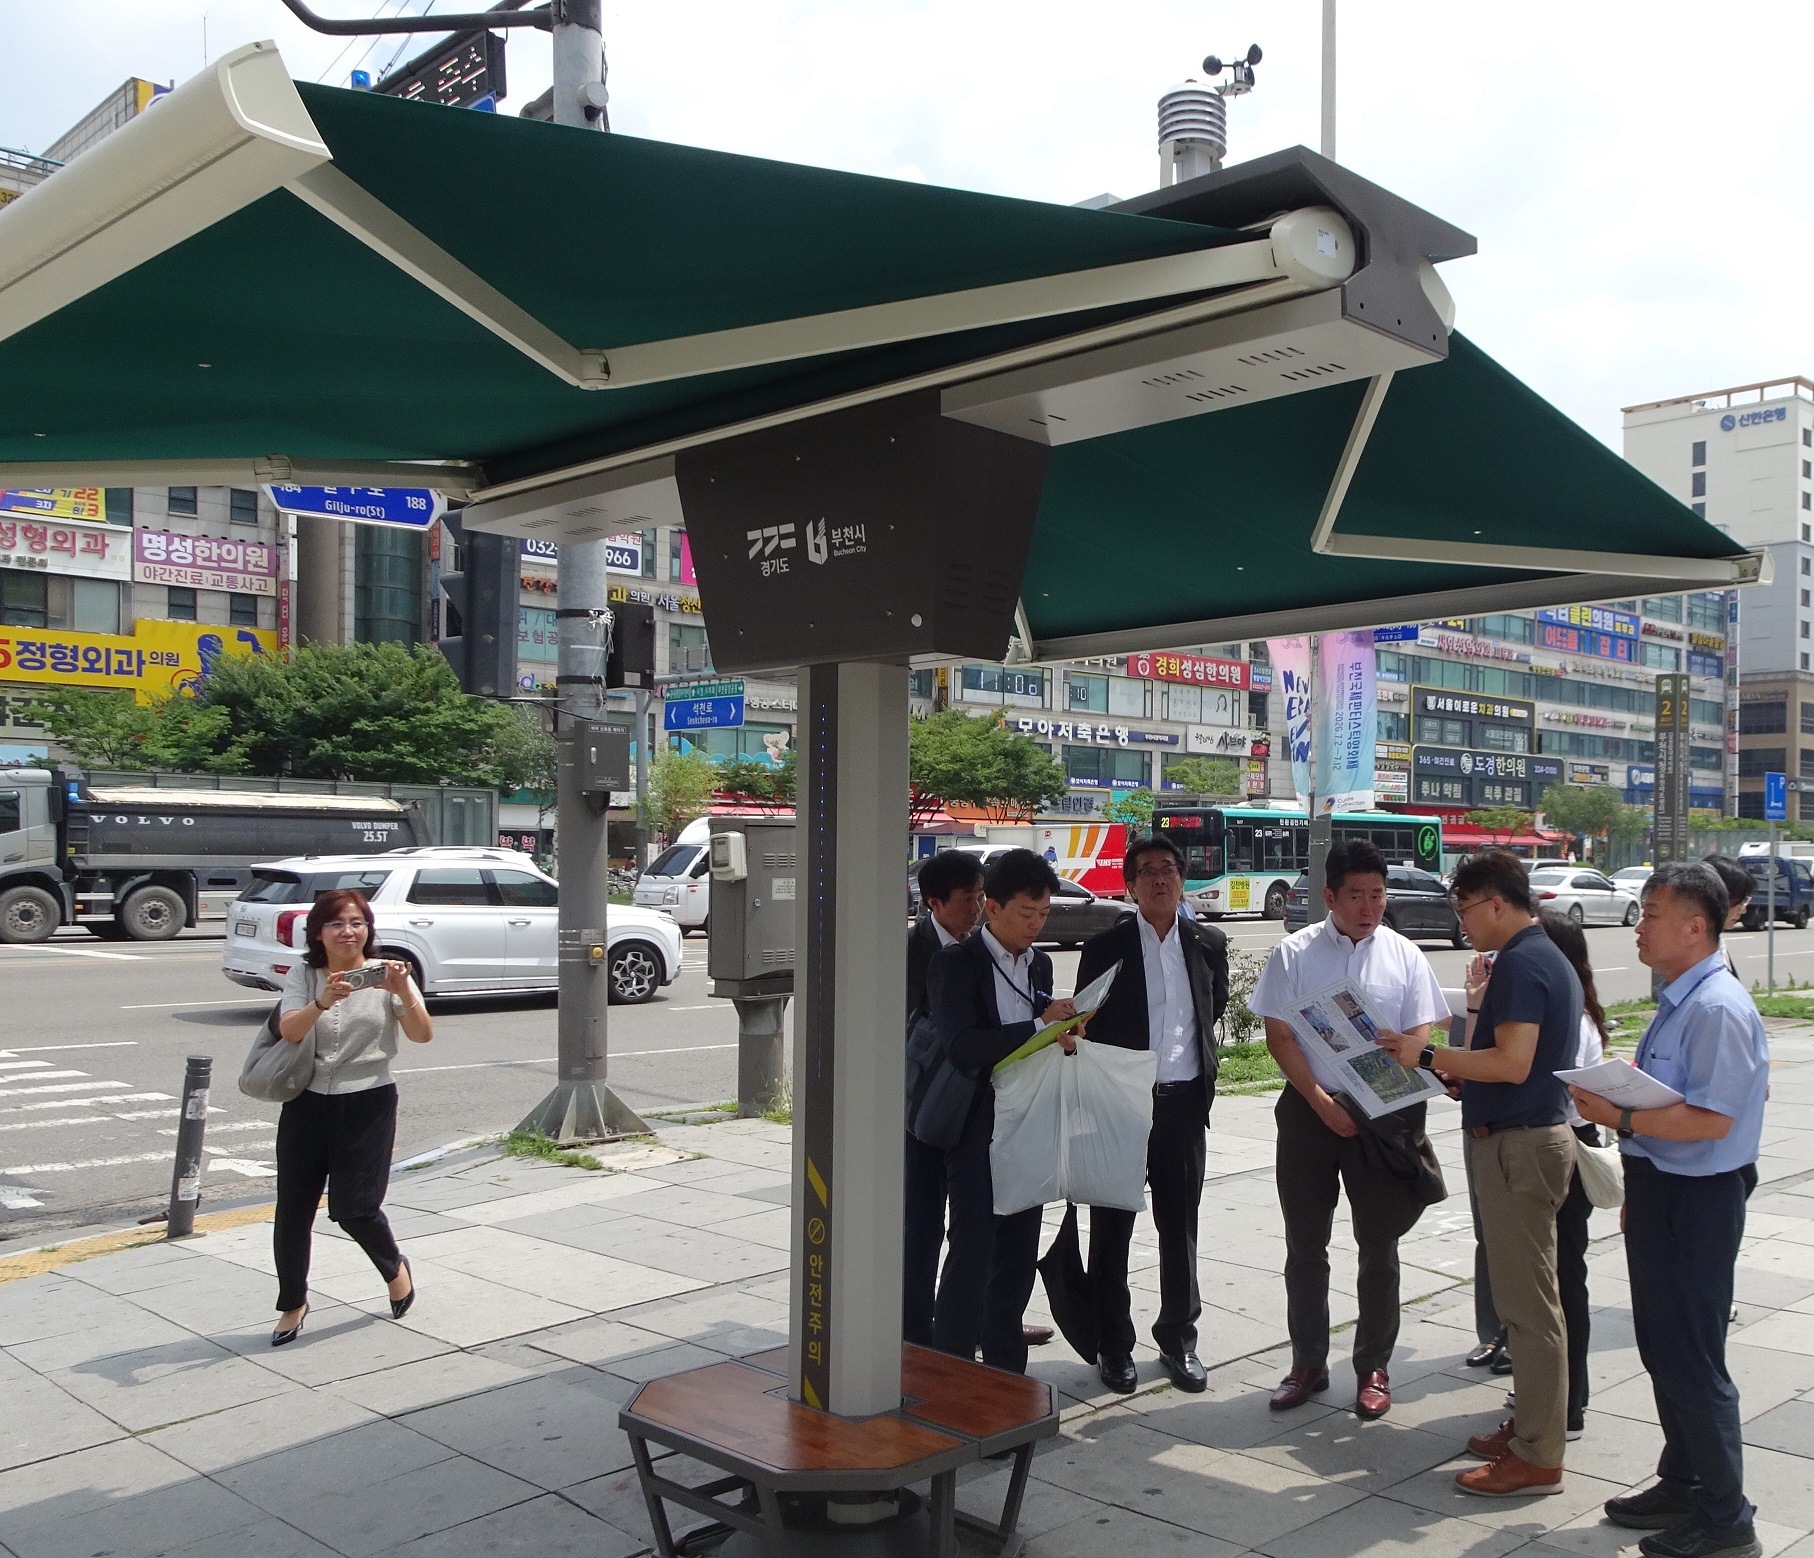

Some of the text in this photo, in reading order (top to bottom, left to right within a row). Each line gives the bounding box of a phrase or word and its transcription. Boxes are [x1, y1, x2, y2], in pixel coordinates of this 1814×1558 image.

[1739, 406, 1787, 428] 신한은행
[325, 500, 385, 519] Gilju-ro(St)
[405, 496, 427, 510] 188
[831, 523, 866, 547] 부천시
[142, 533, 269, 574] 명성한의원
[833, 544, 867, 557] Bucheon City
[760, 557, 790, 577] 경기도
[143, 565, 269, 592] 야간진료 교통사고
[149, 650, 180, 667] 의원
[1155, 656, 1242, 685] 경희성심한의원
[692, 702, 713, 716] 석천로
[1347, 661, 1363, 770] 부천국제판타스틱영화제
[1661, 700, 1671, 715] 2
[1018, 717, 1130, 747] 모아저축은행
[1474, 755, 1526, 778] 도경한의원
[1779, 776, 1786, 790] P
[90, 815, 195, 826] VOLVO
[352, 821, 399, 830] VOLVO DUMPER
[1161, 817, 1170, 828] 23
[1279, 818, 1310, 828] 친환경전기버
[363, 830, 388, 842] 25.5T
[1255, 829, 1263, 837] 23
[808, 1253, 825, 1365] 안전주의
